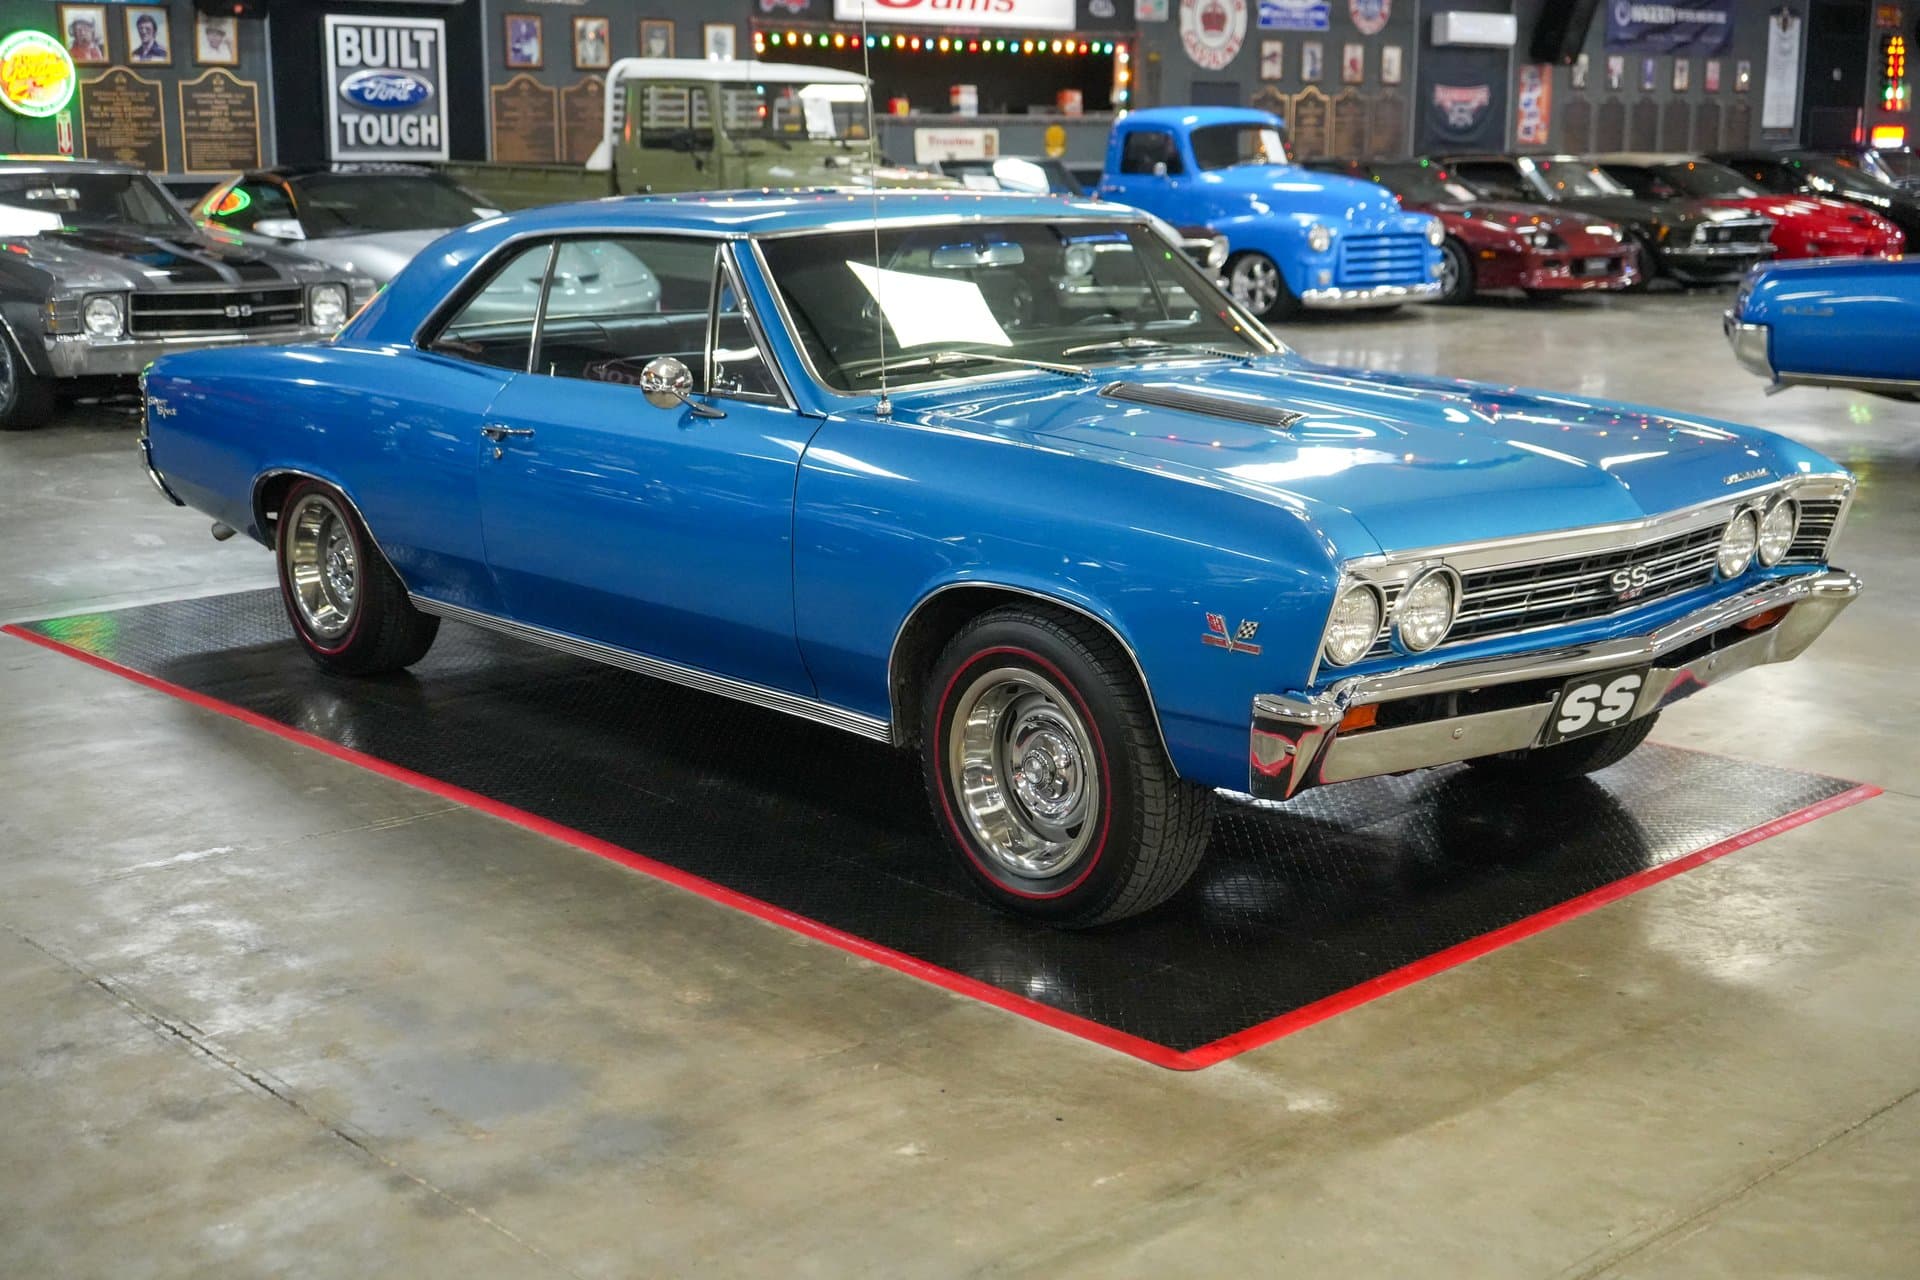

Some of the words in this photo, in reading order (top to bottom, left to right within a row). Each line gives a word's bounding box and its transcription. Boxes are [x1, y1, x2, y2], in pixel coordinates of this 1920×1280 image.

[336, 26, 436, 69] BUILT
[362, 76, 413, 102] Ford
[340, 114, 440, 146] TOUGH
[225, 304, 253, 318] SS
[1612, 565, 1648, 592] SS
[1557, 674, 1642, 733] SS
